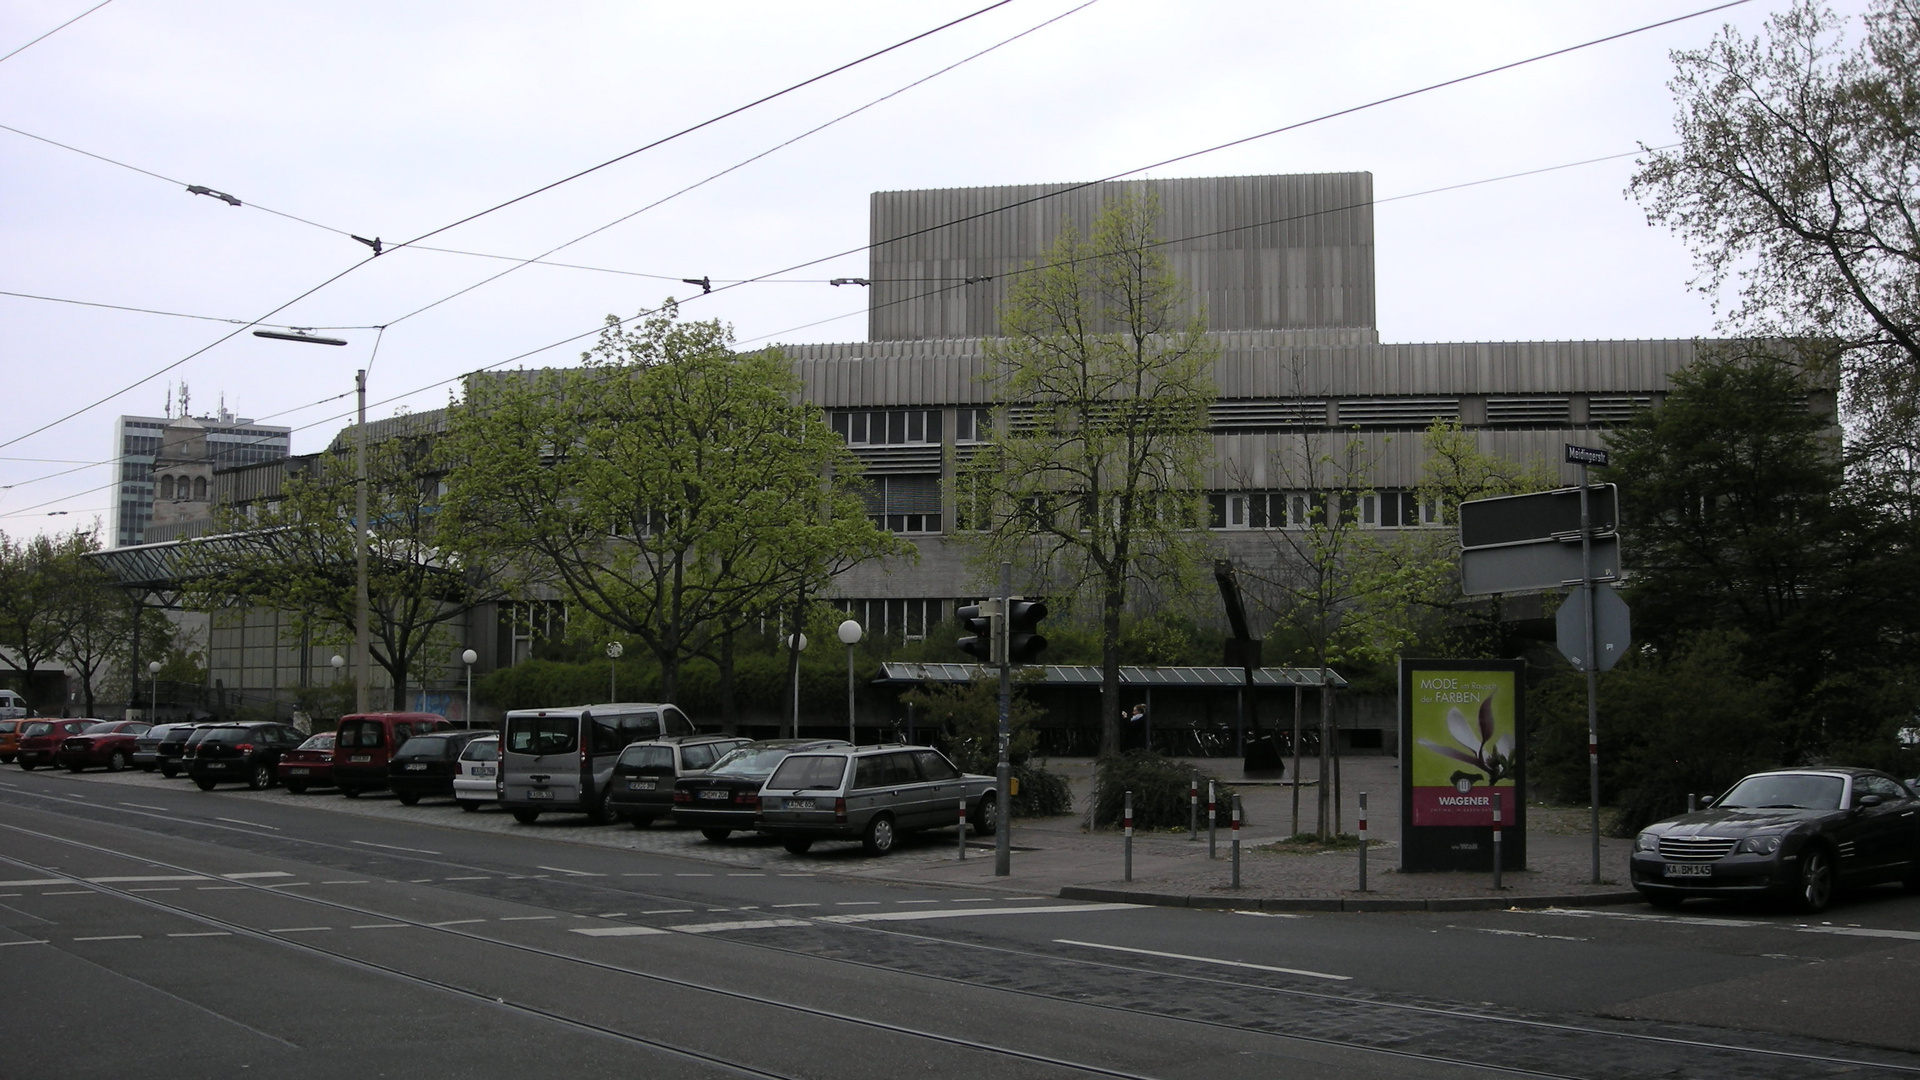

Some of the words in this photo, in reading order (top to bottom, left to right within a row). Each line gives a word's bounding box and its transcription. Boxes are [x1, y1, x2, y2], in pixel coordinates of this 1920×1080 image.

[1569, 446, 1606, 463] Meidingerstr.
[1420, 678, 1458, 690] MODE
[1471, 681, 1497, 690] Rausch
[1420, 695, 1433, 703] der
[1435, 692, 1481, 703] FARBEN
[1438, 796, 1490, 806] WAGENER
[1667, 865, 1677, 875] KA
[1682, 865, 1693, 875] BM
[1694, 865, 1711, 875] 145
